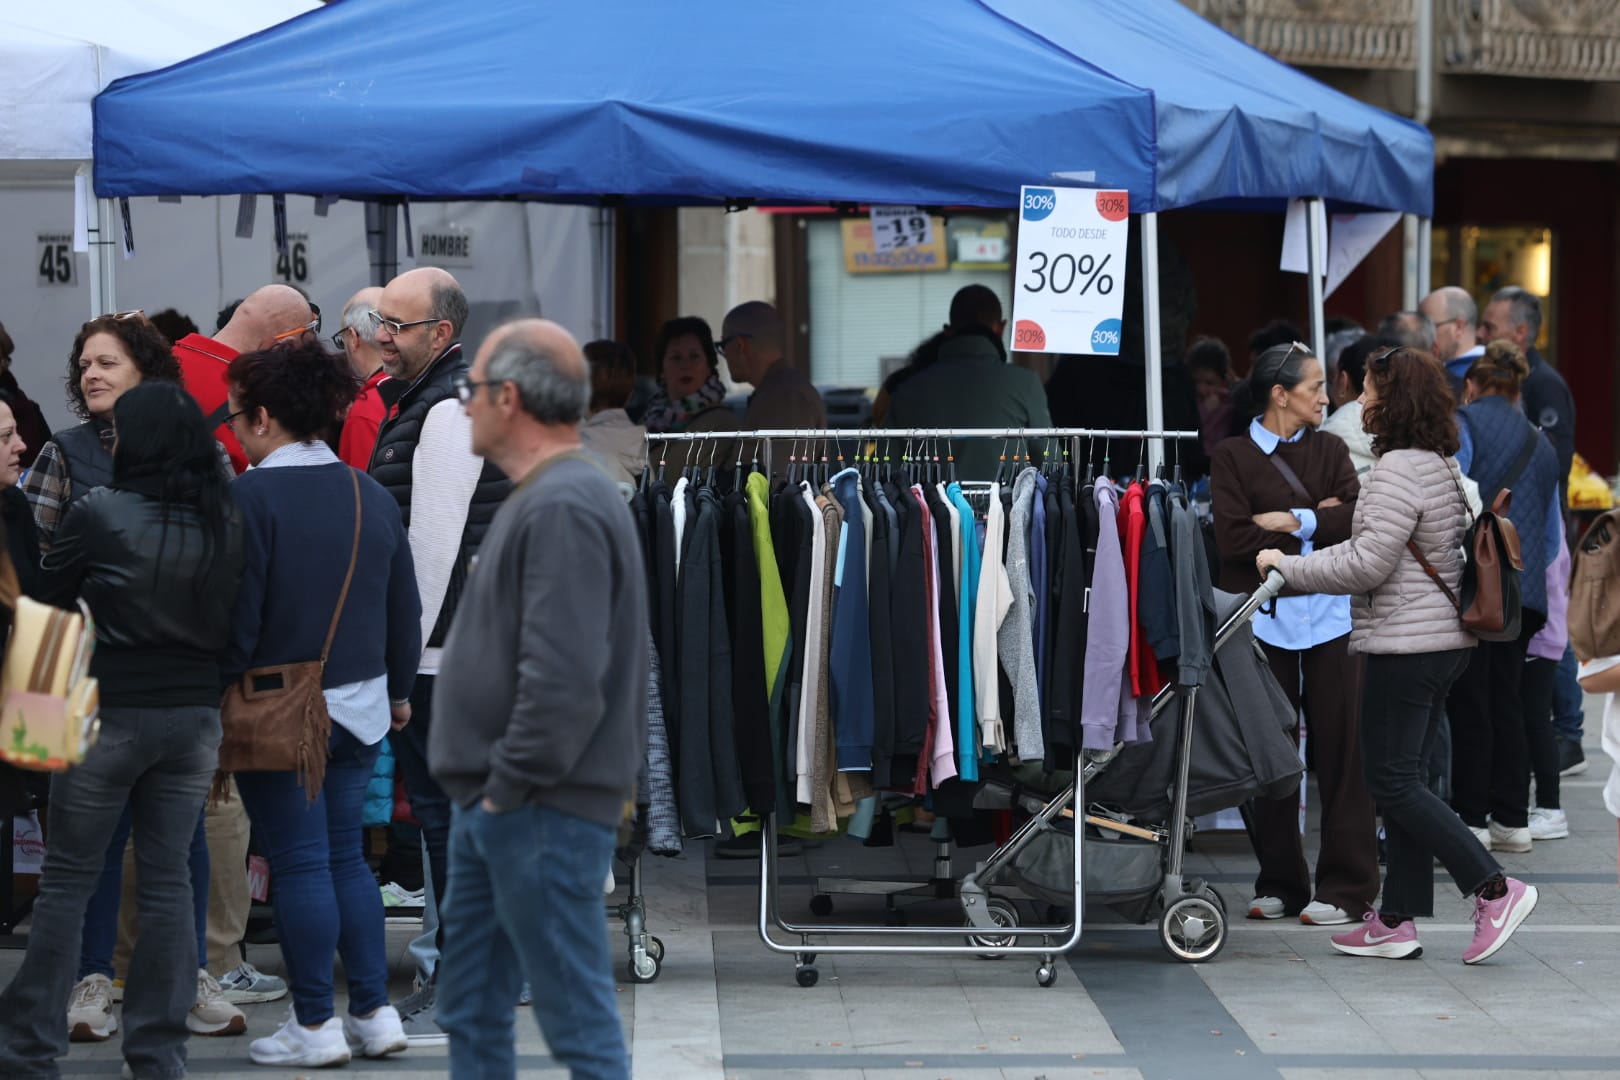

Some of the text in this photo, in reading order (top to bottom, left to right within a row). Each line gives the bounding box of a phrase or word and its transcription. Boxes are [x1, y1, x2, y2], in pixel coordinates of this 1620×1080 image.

[1024, 195, 1054, 210] 30%
[1098, 199, 1125, 213] 30%
[1051, 227, 1107, 240] TODO DESDE
[421, 234, 468, 257] HOMBRE
[40, 245, 71, 284] 45
[277, 242, 307, 283] 46
[1023, 251, 1113, 296] 30%
[1015, 329, 1043, 344] 30%
[1092, 330, 1118, 344] 30%
